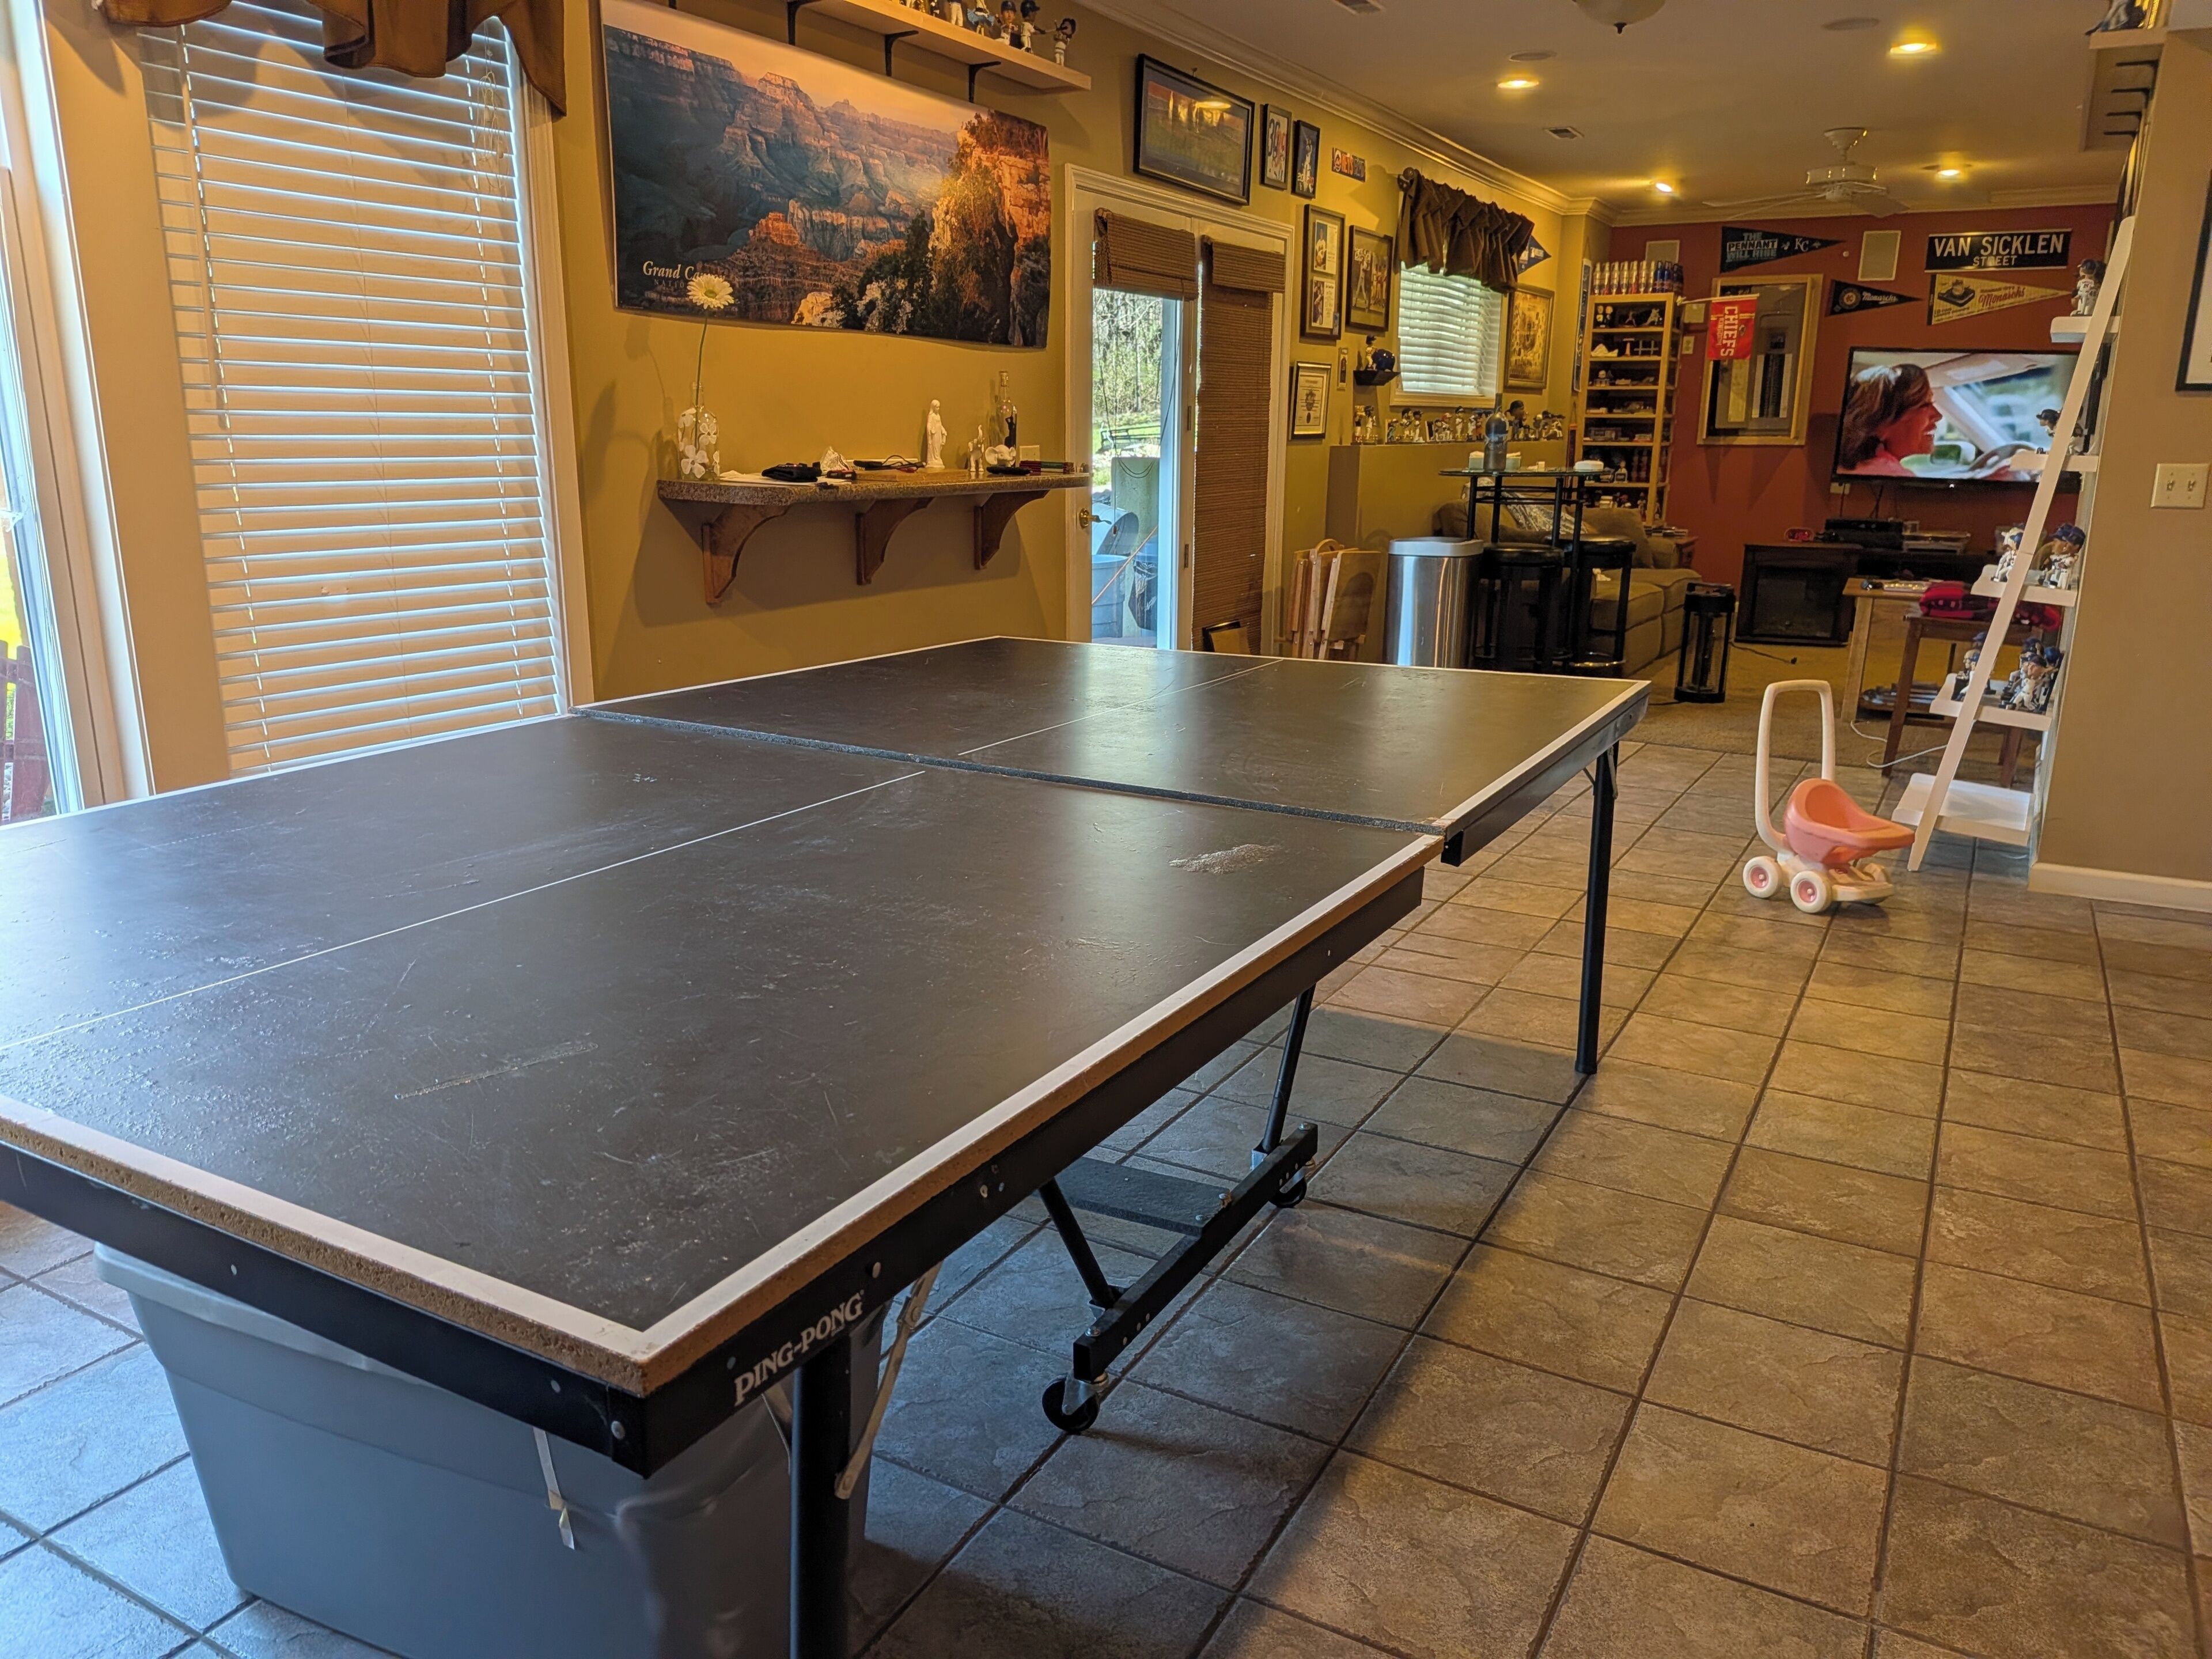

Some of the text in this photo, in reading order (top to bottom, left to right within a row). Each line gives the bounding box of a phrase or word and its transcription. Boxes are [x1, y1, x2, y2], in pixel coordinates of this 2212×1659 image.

[1727, 239, 1778, 252] PENNANT
[1743, 232, 1763, 241] THE
[1795, 237, 1809, 252] KC
[1934, 234, 2064, 257] VAN SICKLEN
[643, 260, 681, 279] Grand
[1720, 306, 1738, 357] CHIEFS
[734, 1294, 863, 1406] PING-PONG
